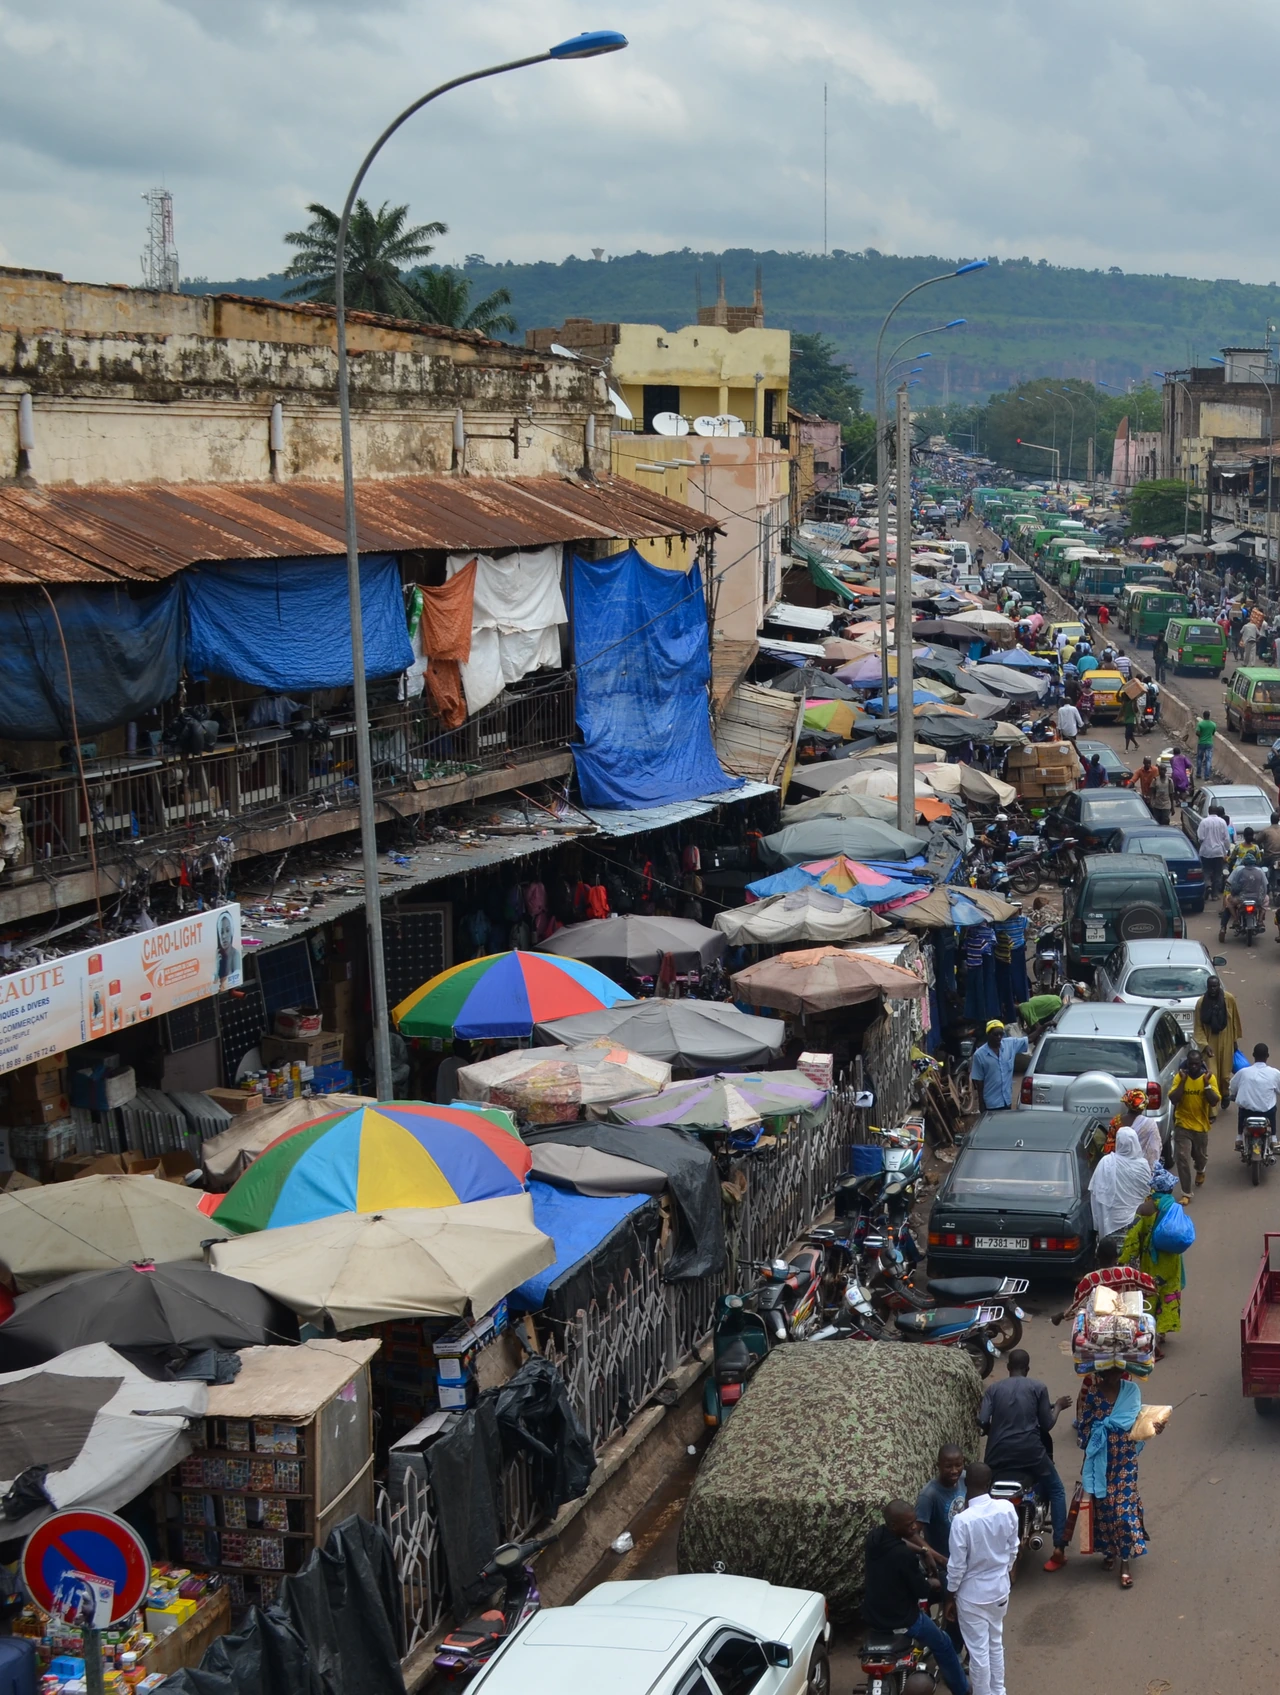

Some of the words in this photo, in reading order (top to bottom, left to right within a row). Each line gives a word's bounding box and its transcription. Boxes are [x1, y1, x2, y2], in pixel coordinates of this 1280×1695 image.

[144, 922, 203, 960] CARO-LIGHT
[0, 966, 65, 1005] AUTE
[21, 1005, 26, 1014] &
[27, 998, 50, 1011] DIVERS
[3, 1012, 49, 1034] COMMERÇANT
[12, 1029, 30, 1040] PEUPLE
[1074, 1105, 1110, 1114] TOYOTA
[976, 1238, 1028, 1249] M-7381-MD
